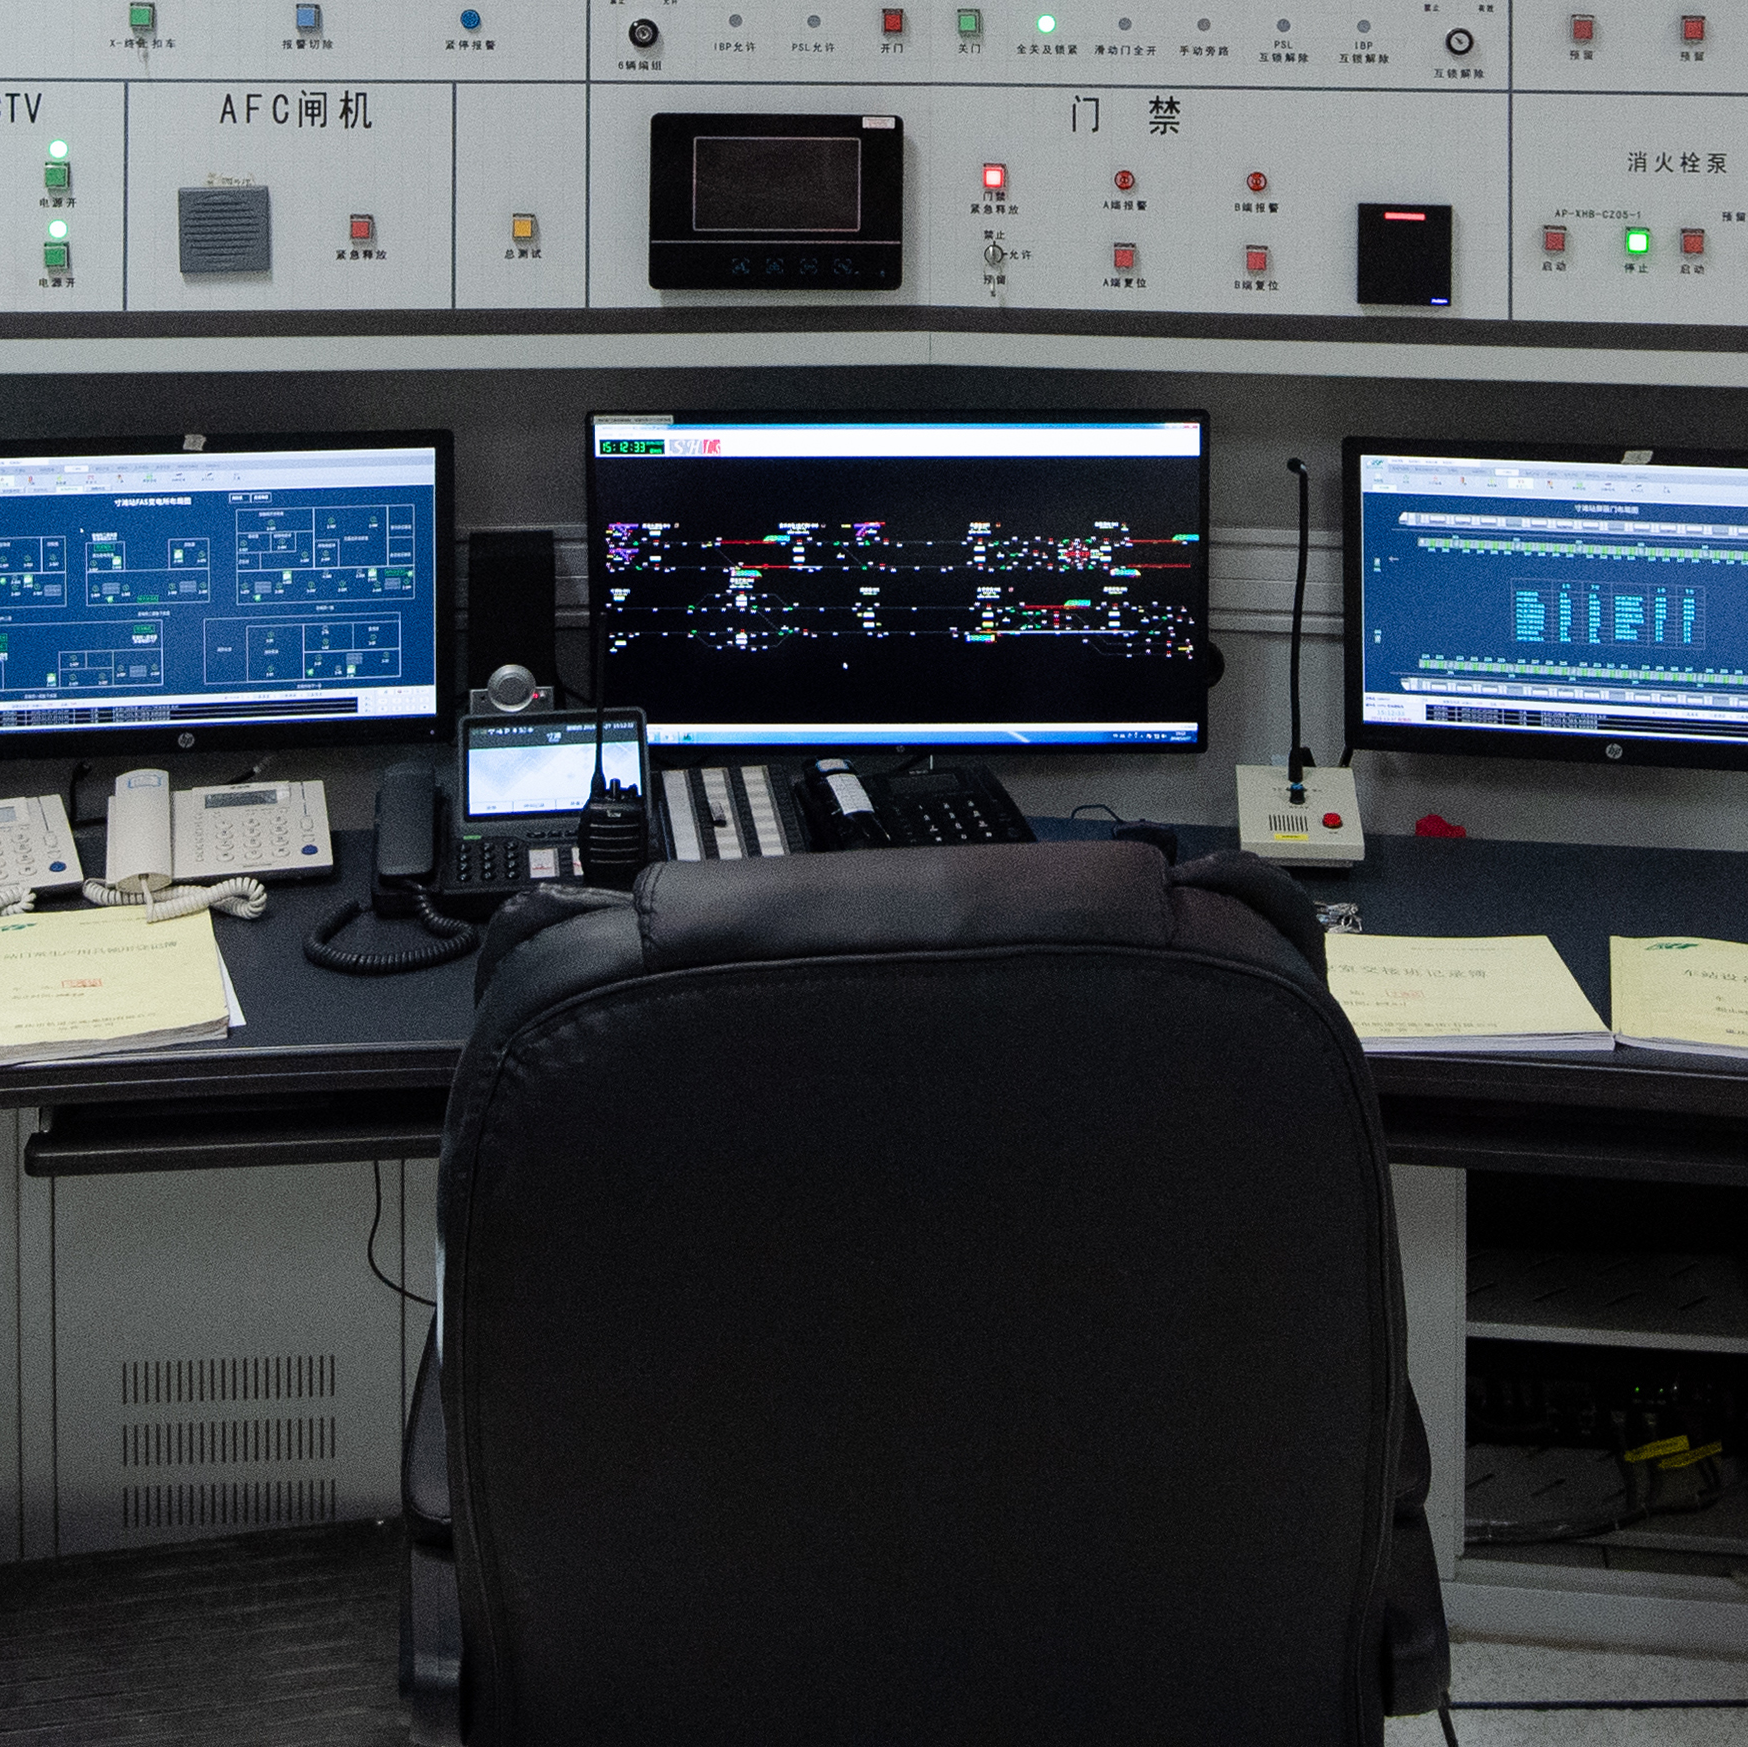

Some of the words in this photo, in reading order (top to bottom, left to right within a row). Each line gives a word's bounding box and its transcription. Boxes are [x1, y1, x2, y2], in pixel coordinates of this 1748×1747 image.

[219, 90, 374, 129] AFC闸机
[1628, 151, 1727, 174] 消火栓泵
